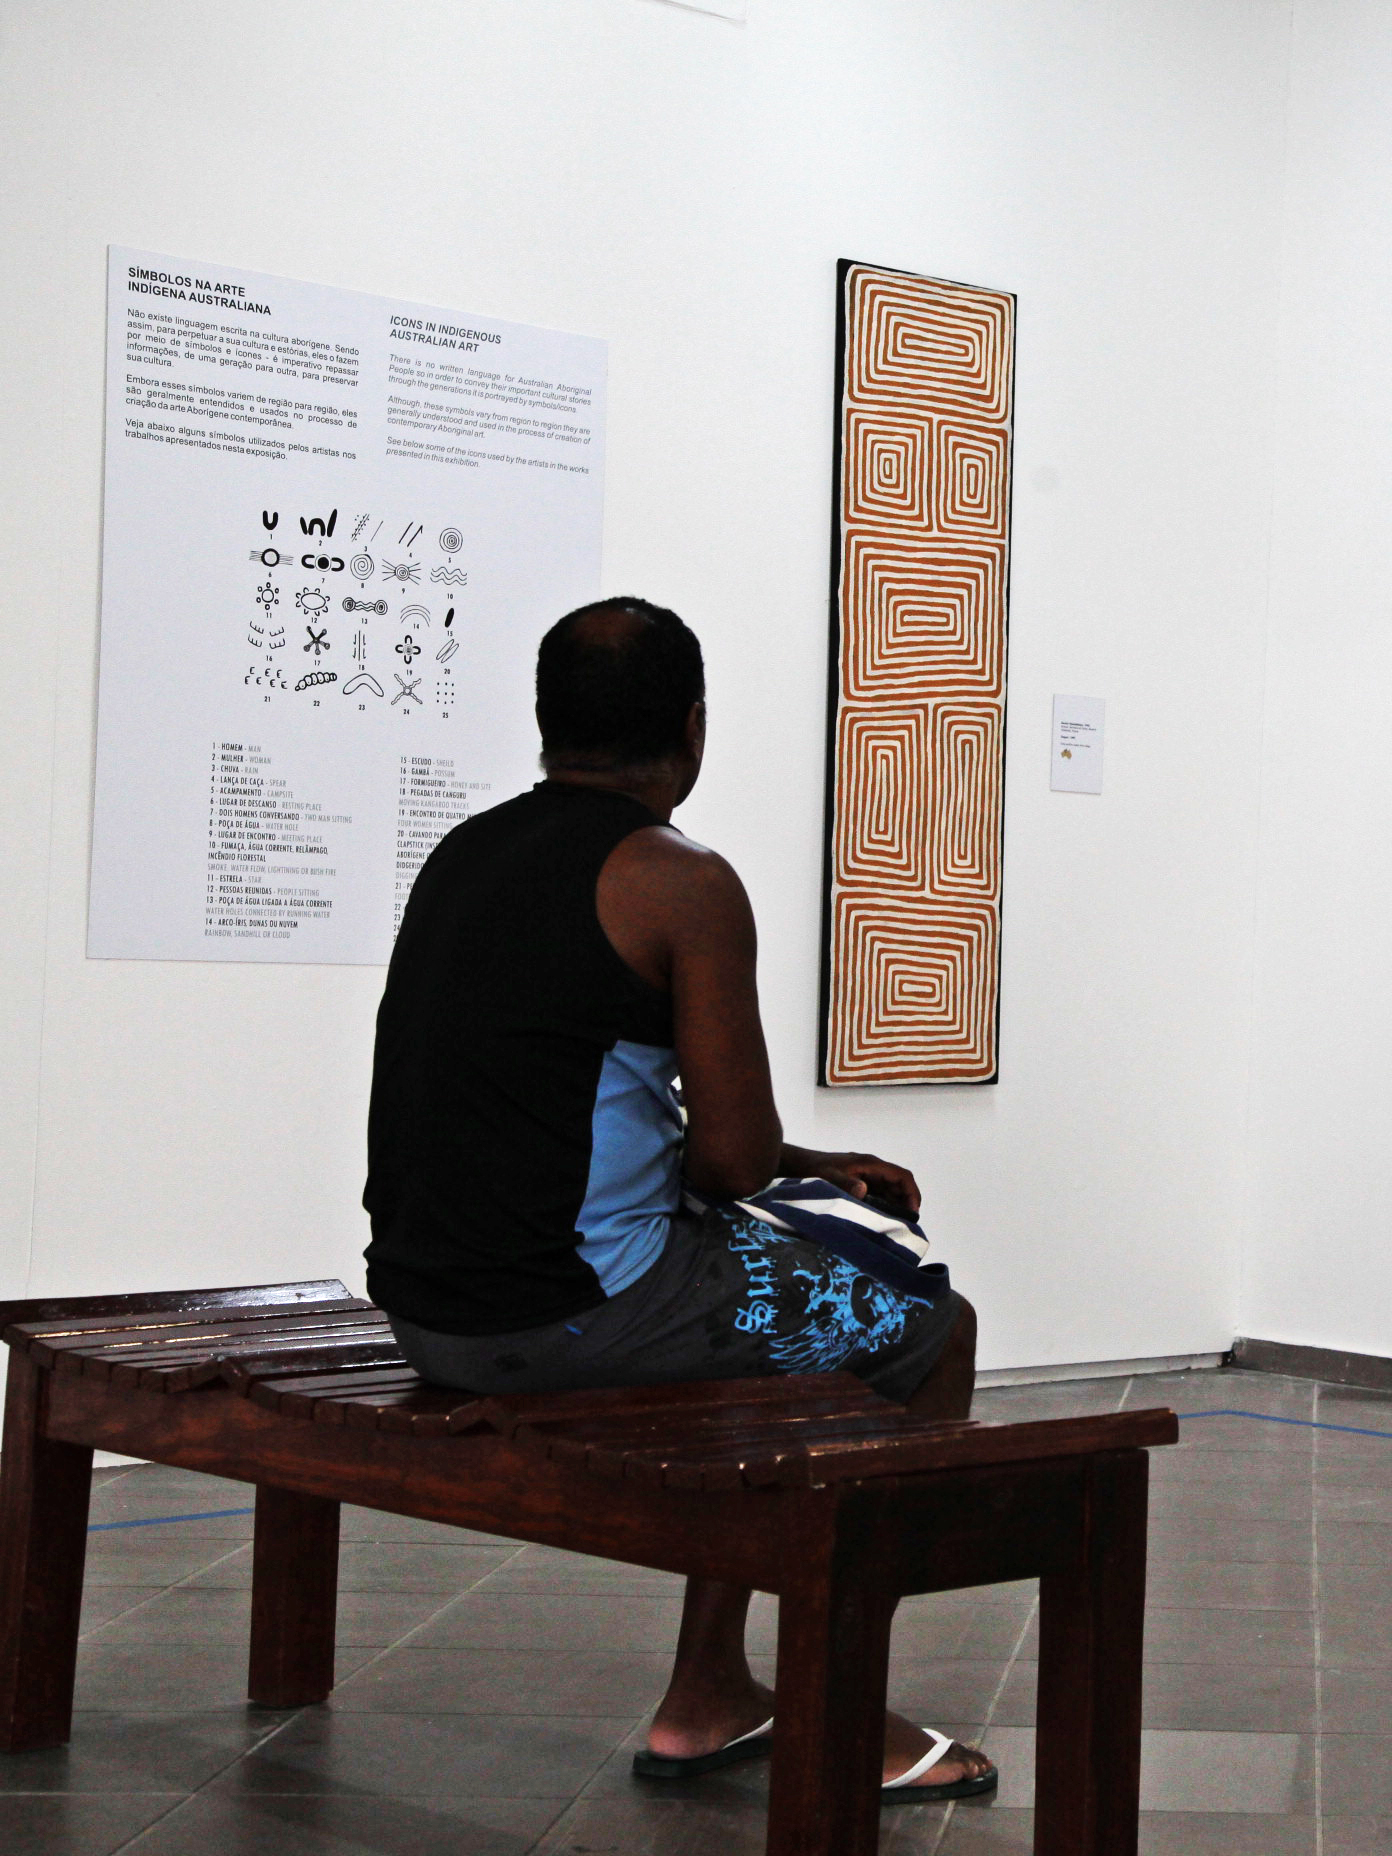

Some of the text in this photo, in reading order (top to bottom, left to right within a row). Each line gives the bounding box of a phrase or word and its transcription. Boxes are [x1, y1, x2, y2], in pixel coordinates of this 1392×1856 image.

[128, 268, 245, 297] SÍMBOLOS NA ARTE
[128, 281, 271, 315] INDÍGENA AUSTRALIANA
[128, 309, 145, 319] Não
[147, 314, 173, 324] existe
[175, 317, 218, 332] linguagem
[220, 326, 248, 337] escrita
[262, 333, 289, 344] cultura
[335, 344, 359, 356] Sendo
[390, 316, 502, 344] ICONS IN INDIGENOUS
[127, 321, 155, 333] assim,
[156, 326, 176, 335] para
[177, 329, 217, 342] perpetuar
[226, 337, 241, 346] sua
[242, 340, 269, 350] cultura
[312, 351, 328, 360] eles
[336, 354, 359, 366] fazem
[390, 329, 479, 352] AUSTRALIAN ART
[126, 354, 142, 363] sua
[127, 332, 140, 341] por
[145, 336, 166, 345] meio
[170, 338, 181, 347] de
[282, 356, 322, 370] imperativo
[325, 365, 359, 376] repassar
[126, 342, 358, 386] informações, de uma geração para outra, para preservar
[390, 355, 592, 395] There written language Australian Aboriginal
[388, 364, 592, 405] People order convey their important cultural stories
[388, 376, 417, 388] through
[429, 384, 472, 396] generations
[484, 393, 518, 404] portrayed
[126, 375, 160, 387] Embora
[161, 382, 186, 391] esses
[227, 392, 254, 402] variem
[256, 394, 266, 404] de
[268, 398, 293, 408] região
[294, 402, 312, 411] para
[314, 405, 340, 416] região,
[342, 408, 358, 418] eles
[126, 398, 157, 409] criação
[157, 401, 169, 410] da
[170, 405, 186, 413] arte
[126, 387, 142, 395] são
[147, 390, 194, 403] geralmente
[199, 398, 245, 411] entendidos
[259, 407, 288, 418] usados
[308, 415, 343, 426] processo
[347, 419, 357, 428] de
[423, 402, 444, 412] these
[445, 406, 475, 416] symbols
[509, 416, 532, 426] region
[540, 421, 563, 430] region
[386, 418, 474, 436] contemporary Aboriginal
[387, 406, 583, 443] generally understood process creation
[125, 429, 289, 460] trabalhos apresentados nesta exposição.
[126, 418, 144, 430] Veja
[147, 422, 175, 433] abaixo
[178, 426, 206, 437] alguns
[248, 437, 285, 449] utilizados
[288, 443, 309, 452] pelos
[312, 446, 340, 456] artistas
[386, 448, 423, 459] presented
[402, 439, 590, 474] below icons artists works
[221, 743, 244, 751] HOMEM
[220, 754, 244, 763] MULHER
[411, 758, 432, 766] ESCUDO
[220, 765, 240, 773] CHUVA
[220, 776, 264, 787] LANÇA CAÇA
[410, 779, 447, 788] FORMIGUEIRO
[220, 787, 262, 797] ACAMPAMENTO
[410, 789, 467, 799] PEGADAS CANGURU
[219, 798, 277, 809] LUGAR DESCANSO
[234, 810, 258, 818] HOMENS
[259, 812, 300, 821] CONVERSANDO
[409, 810, 437, 818] ENCONTRO
[445, 812, 466, 820] QUATRO
[218, 820, 234, 829] POÇA
[246, 832, 277, 841] ENCONTRO
[207, 851, 266, 863] INCÊNDIO FLORESTAL
[295, 844, 329, 855] RELÂMPAGO,
[244, 887, 272, 895] REUNIDAS
[218, 897, 235, 906] POÇA
